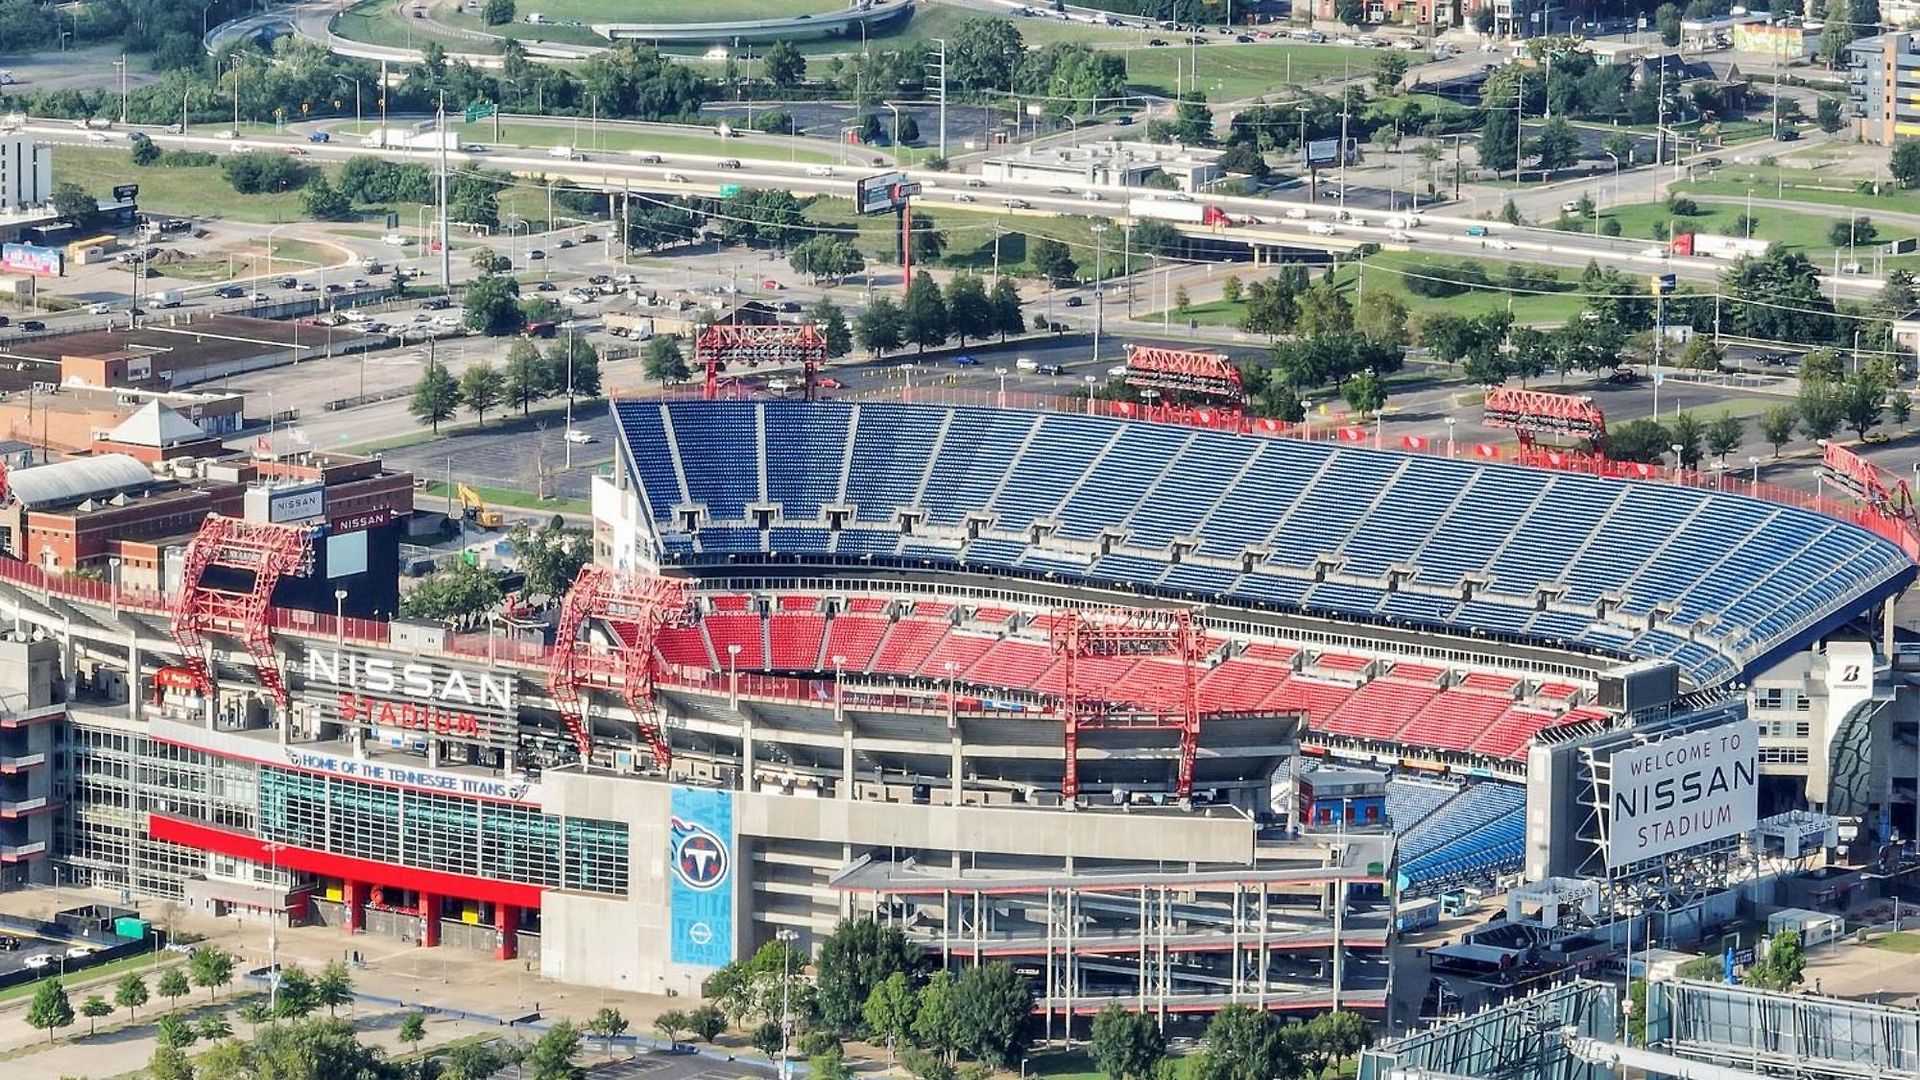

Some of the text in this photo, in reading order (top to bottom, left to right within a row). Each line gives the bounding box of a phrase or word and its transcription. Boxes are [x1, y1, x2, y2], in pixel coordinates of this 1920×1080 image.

[278, 497, 316, 510] NISSAN
[339, 514, 384, 530] NISSAN
[309, 649, 511, 710] NISSAN
[339, 692, 479, 737] STADIUM
[303, 754, 506, 797] HOME OF THE TENNESSEE TITANS
[1630, 734, 1741, 777] WELCOME TO
[1615, 757, 1755, 822] NISSAN
[1638, 804, 1732, 848] STADIUM
[1799, 819, 1833, 835] NISSAN
[1559, 887, 1593, 902] NISSAN
